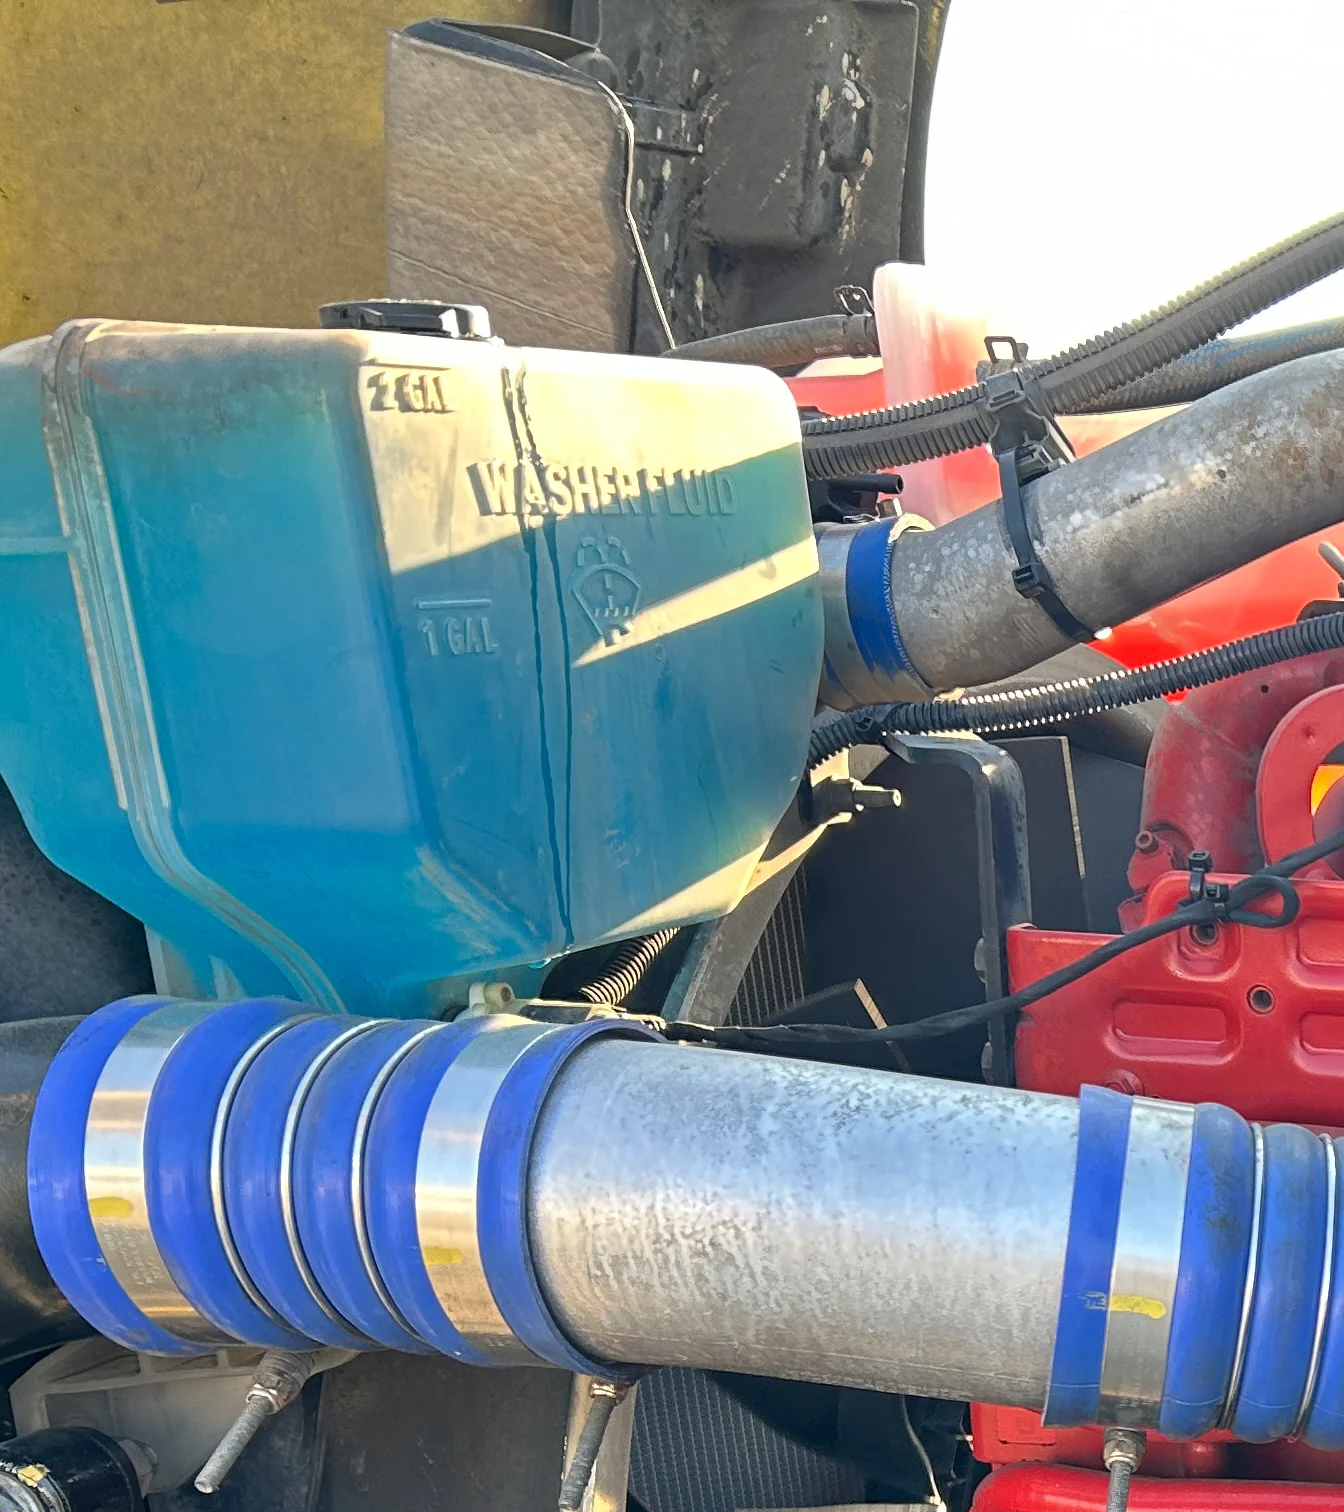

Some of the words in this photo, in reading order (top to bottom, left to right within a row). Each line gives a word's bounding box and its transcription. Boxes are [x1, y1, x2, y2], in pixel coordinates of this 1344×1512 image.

[396, 374, 456, 413] GAL
[467, 461, 642, 517] WASHER
[644, 467, 739, 517] FLUID
[419, 619, 438, 656] 1
[446, 617, 498, 655] GAL
